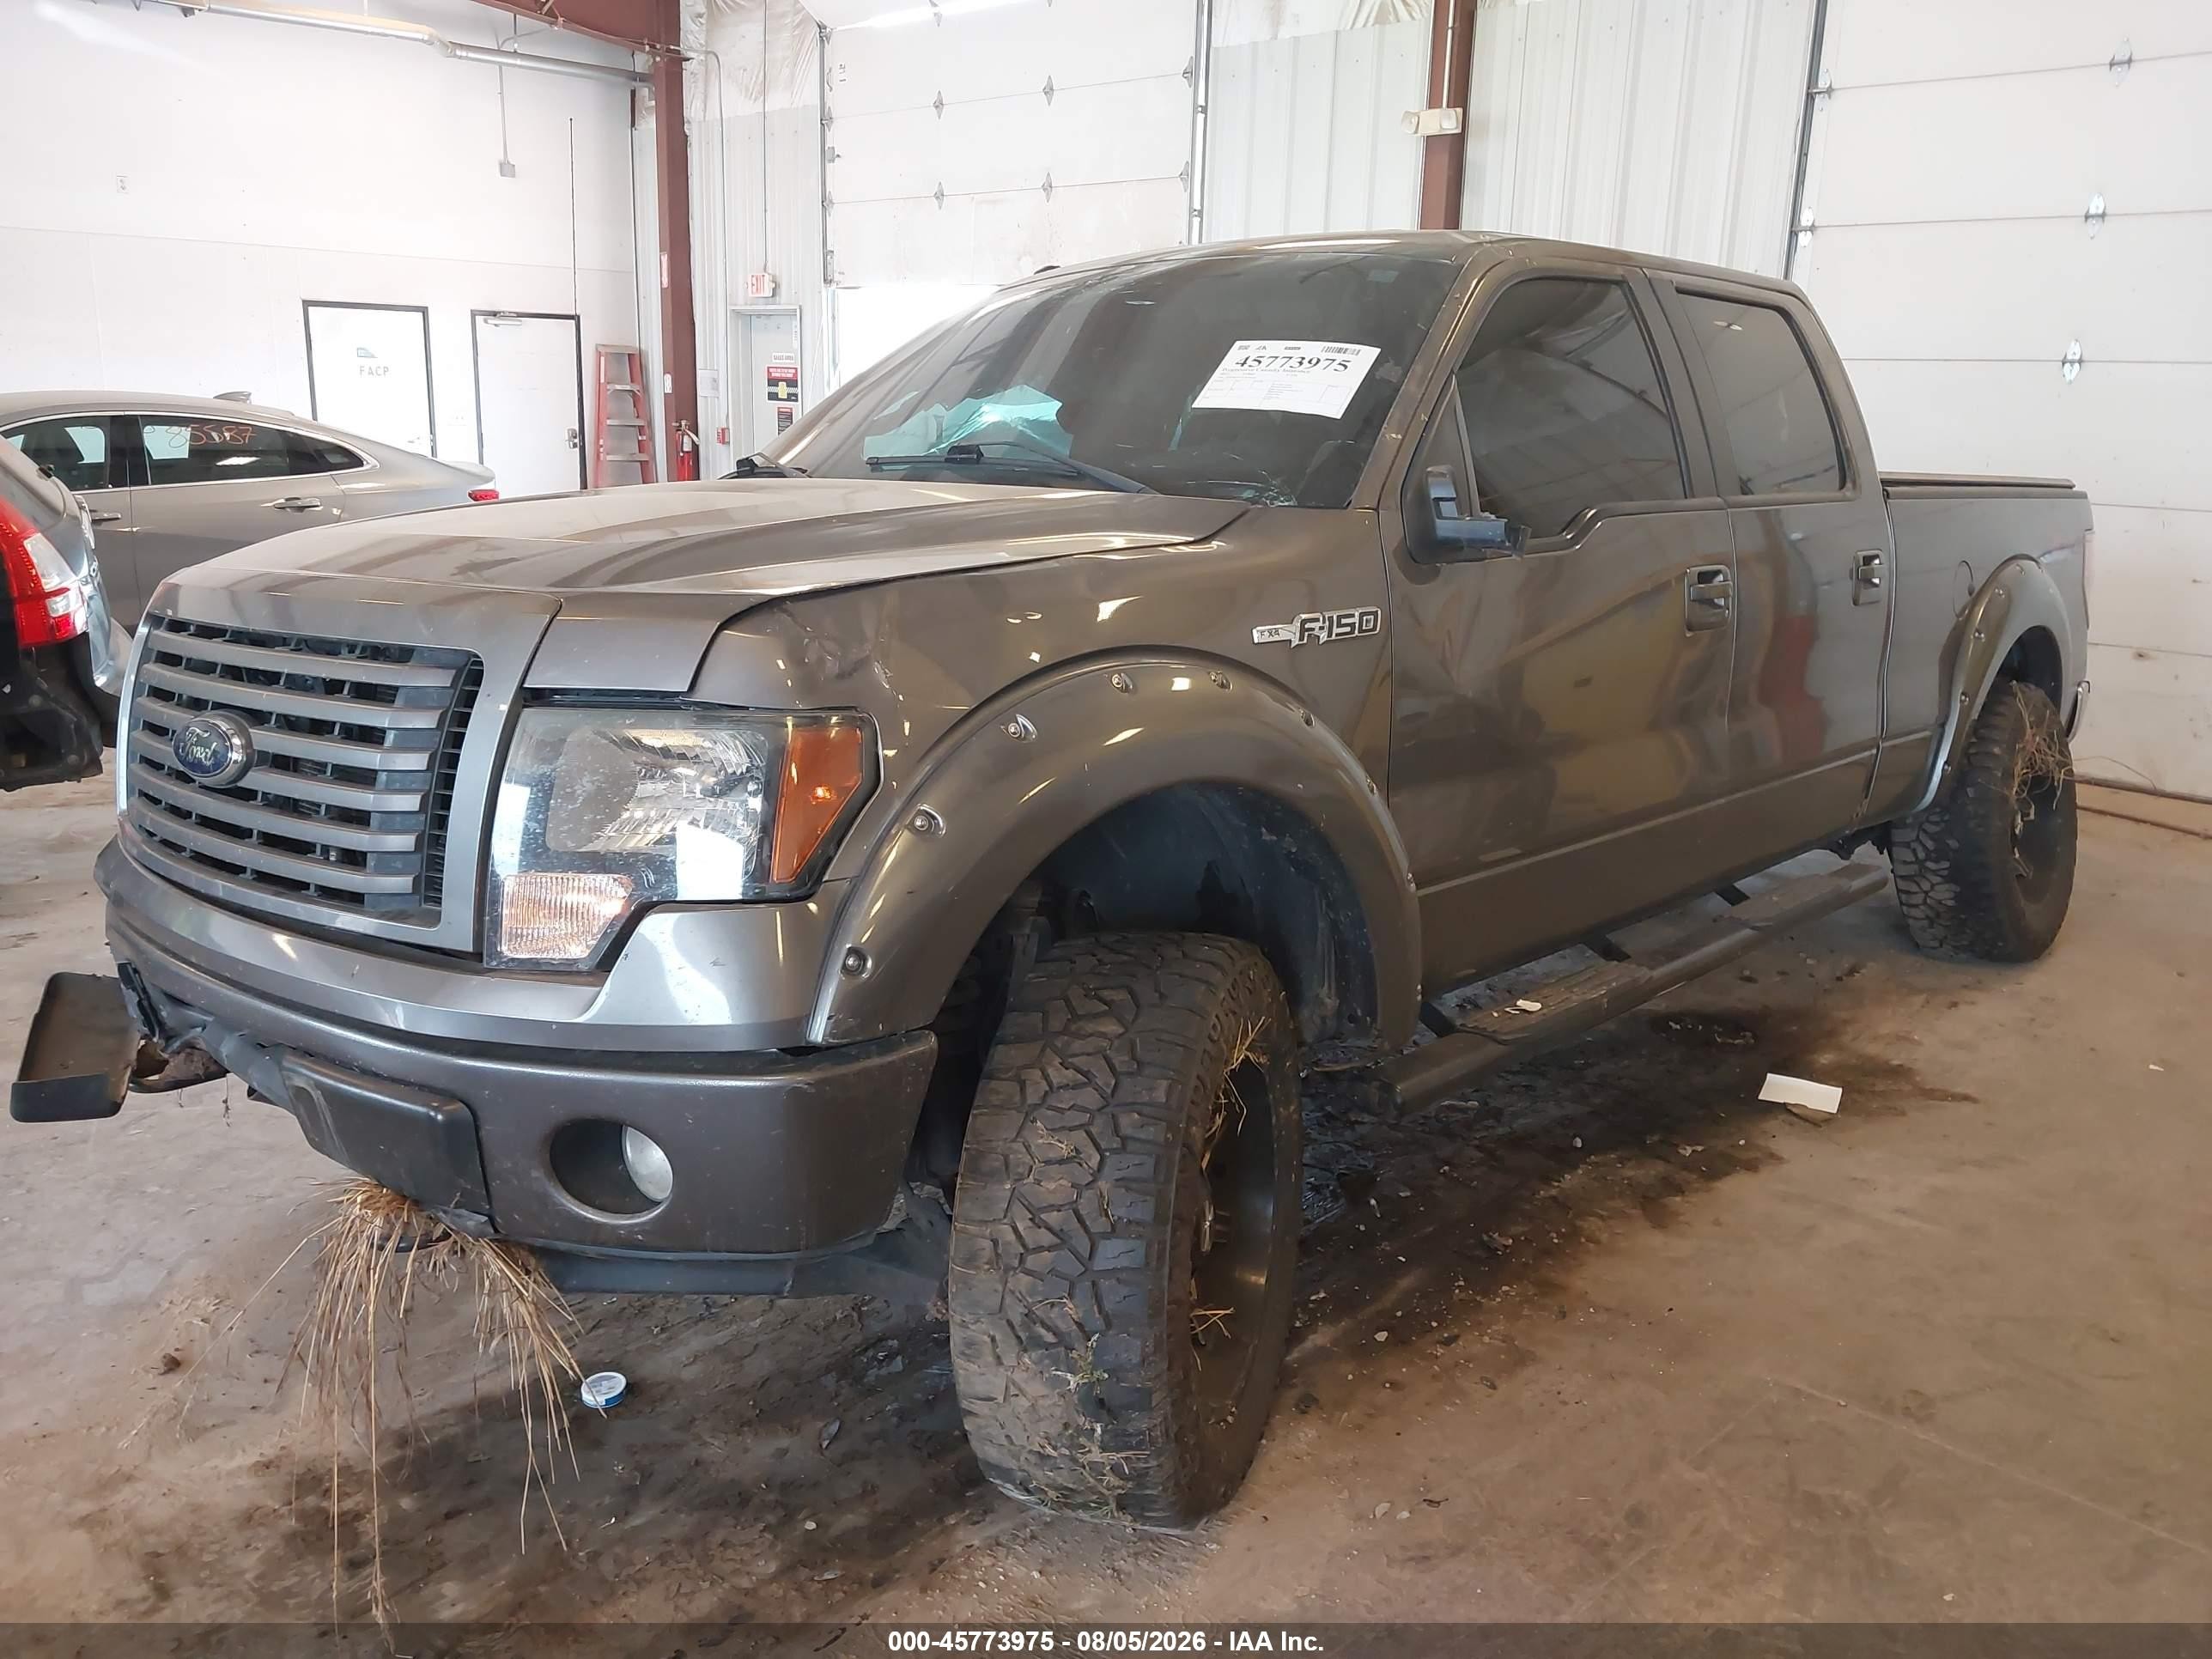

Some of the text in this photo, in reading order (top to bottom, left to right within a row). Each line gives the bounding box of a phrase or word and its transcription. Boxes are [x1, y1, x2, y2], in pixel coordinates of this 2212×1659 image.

[751, 274, 765, 295] EXIT
[359, 365, 389, 377] FACP
[1235, 356, 1352, 372] 45773975
[1260, 607, 1382, 644] FX4 F-150
[176, 726, 218, 766] Ford
